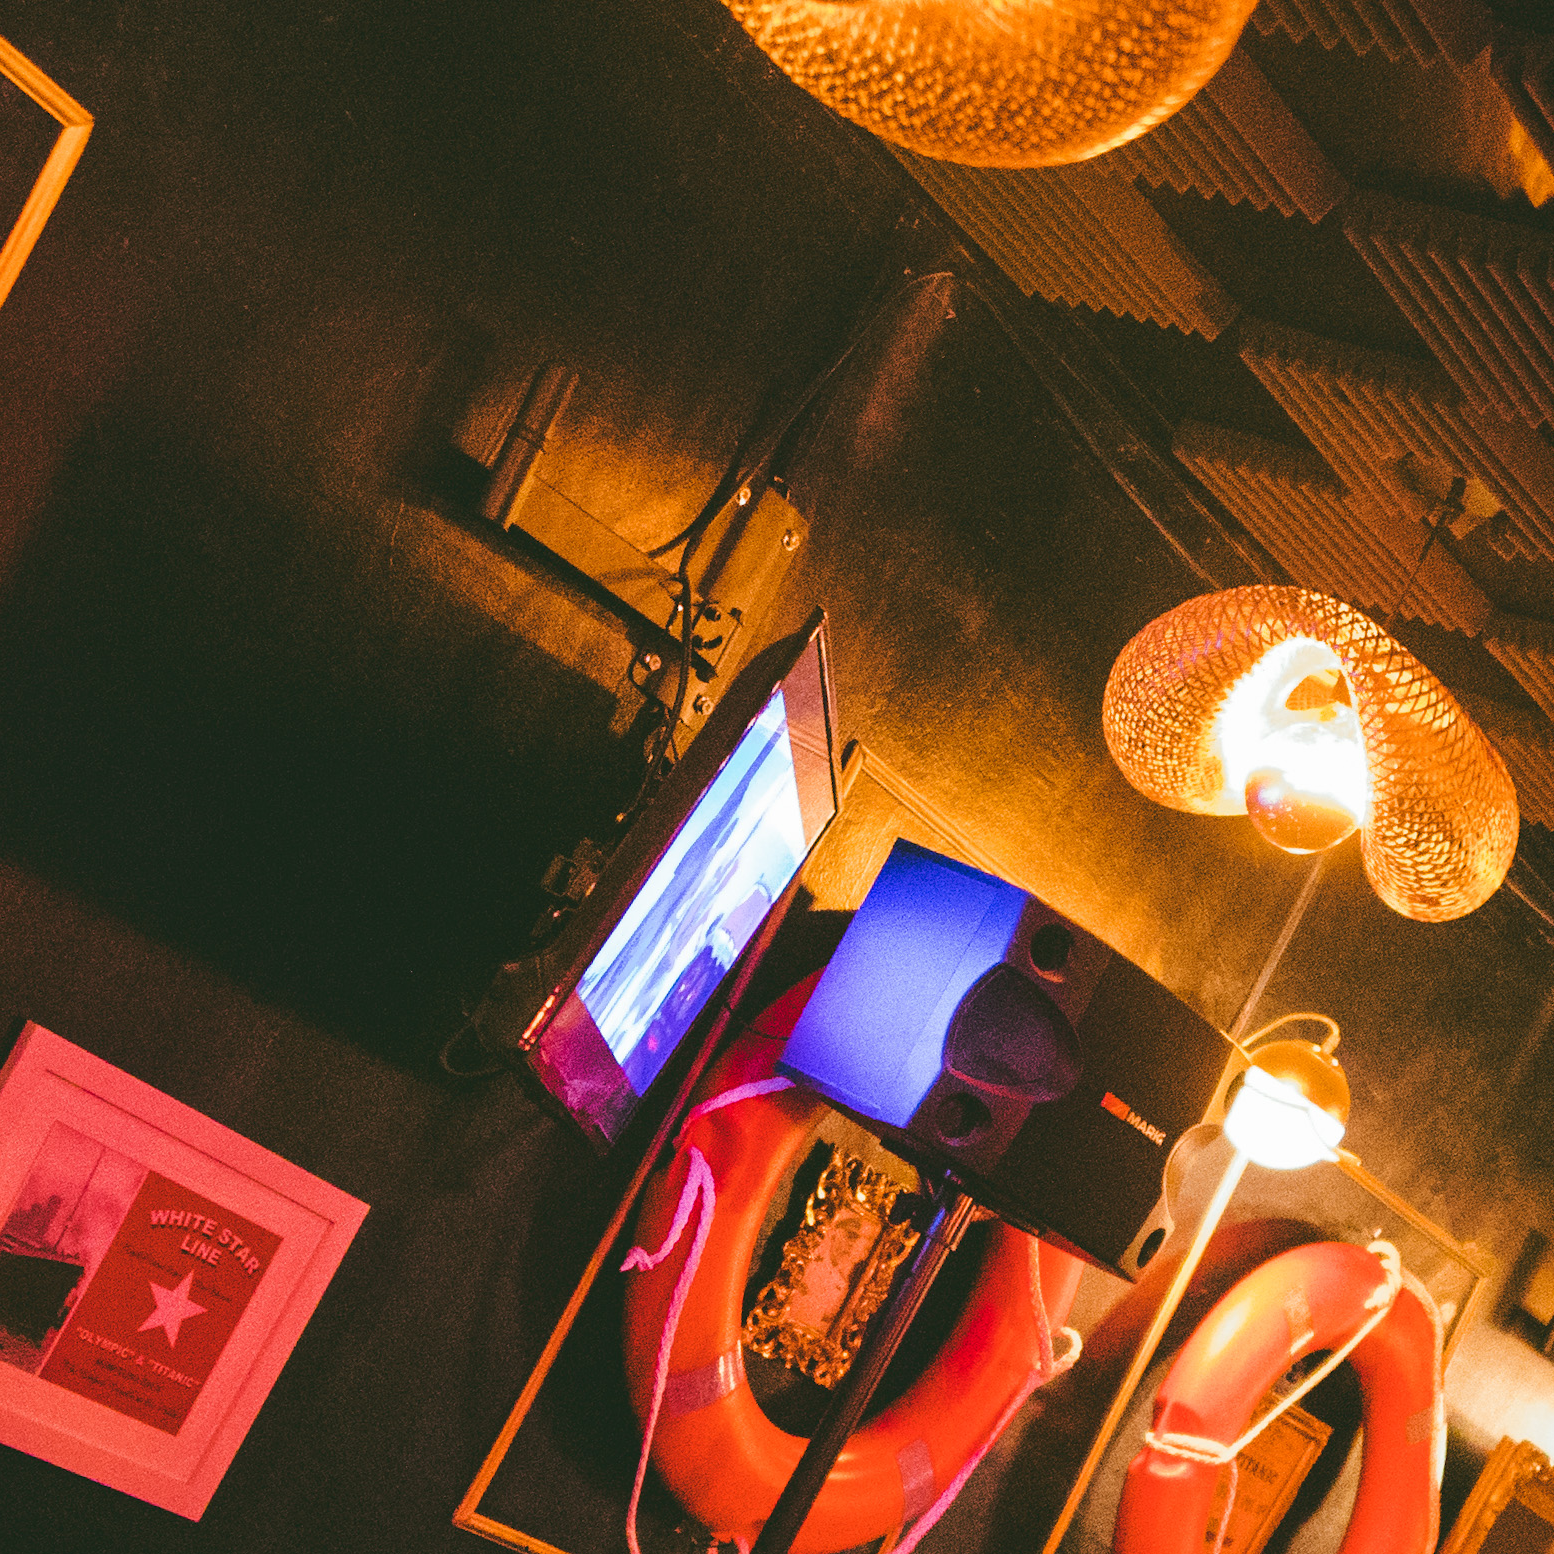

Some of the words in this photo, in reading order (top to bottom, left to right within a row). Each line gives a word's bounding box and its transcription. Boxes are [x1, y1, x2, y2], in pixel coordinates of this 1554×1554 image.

[150, 1209, 218, 1237] WHITE
[218, 1228, 260, 1275] STAR
[180, 1234, 222, 1267] LINE
